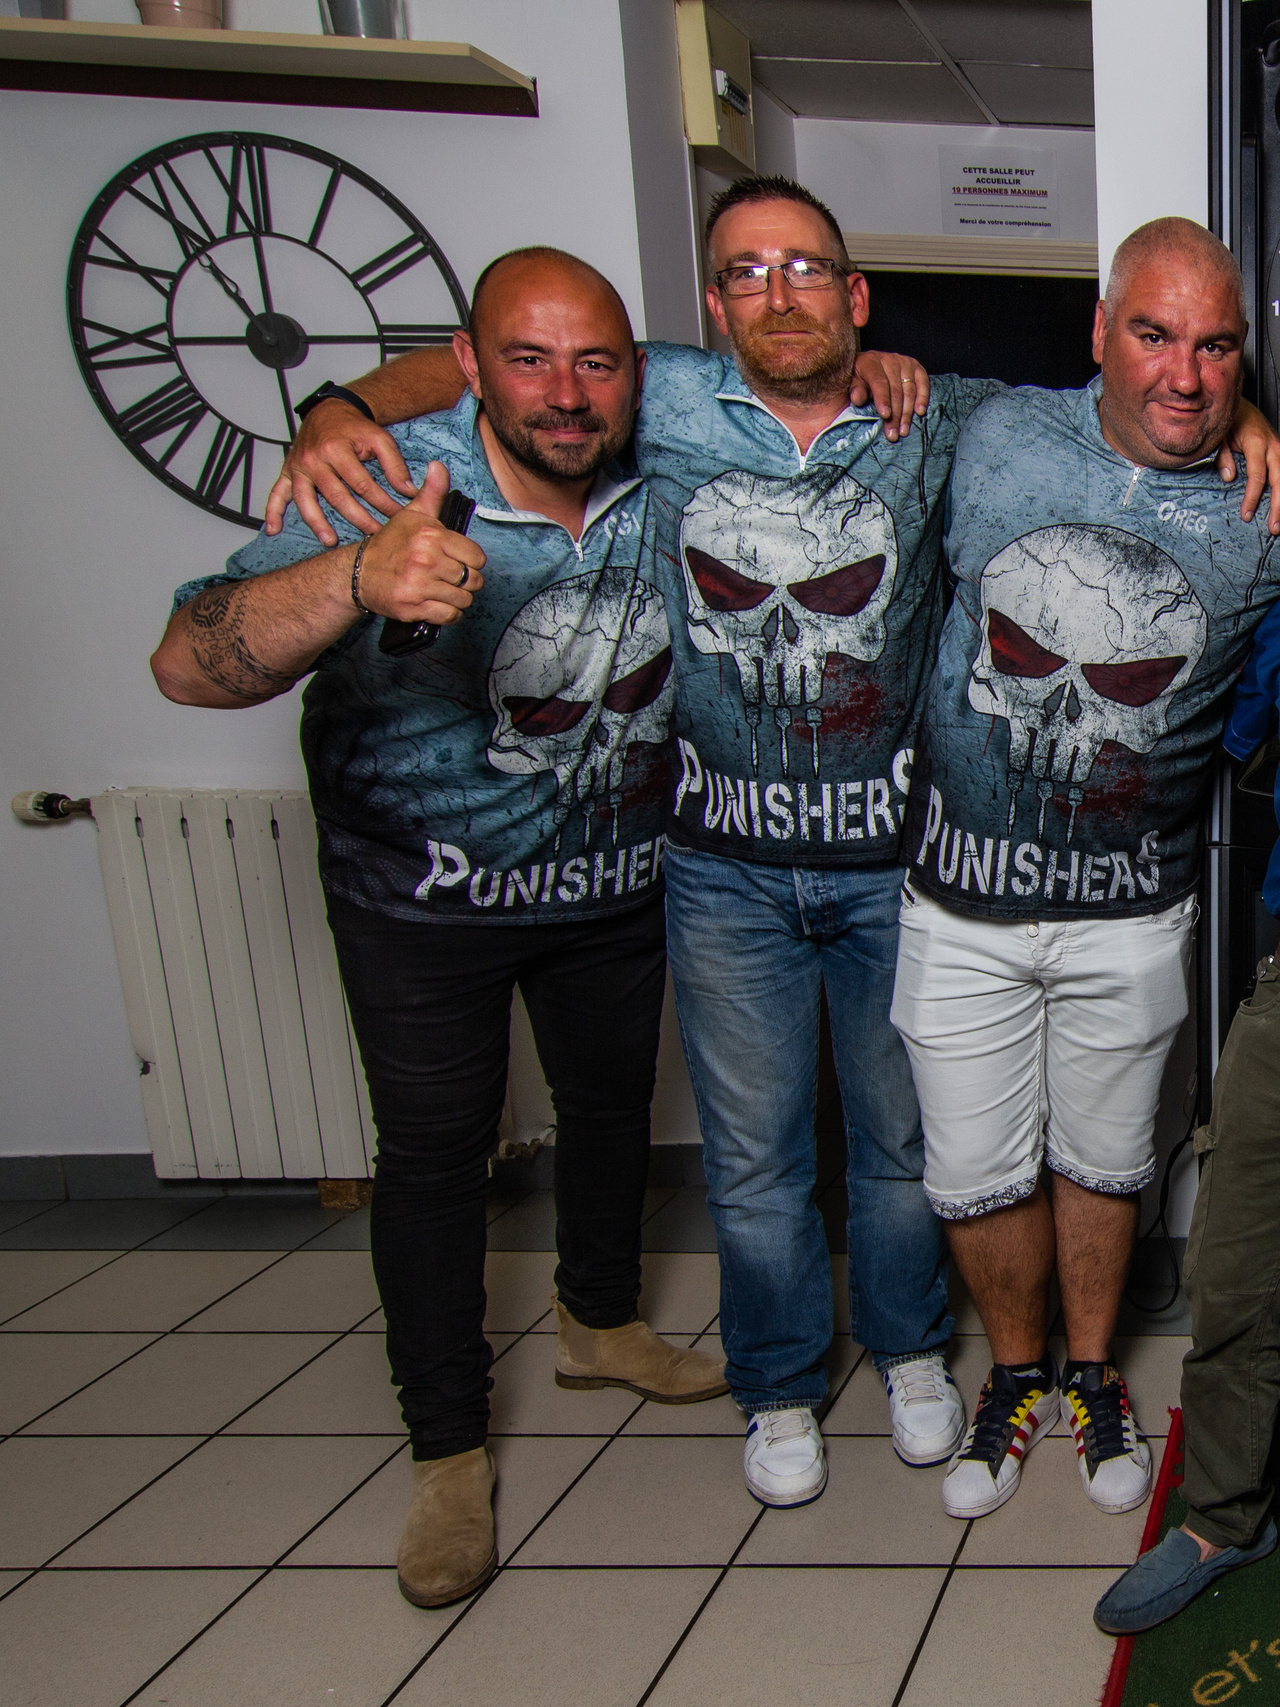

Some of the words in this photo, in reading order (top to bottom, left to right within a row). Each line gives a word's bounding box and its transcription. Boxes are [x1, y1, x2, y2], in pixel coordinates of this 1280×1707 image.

[962, 166, 987, 174] CETTE
[1015, 168, 1035, 176] PEUT
[976, 177, 1021, 185] ACCUEILLIR
[963, 187, 1008, 195] PERSONNES
[1010, 188, 1048, 197] MAXIMUM
[1157, 500, 1208, 534] GREG
[916, 784, 1161, 903] PUNISHERS
